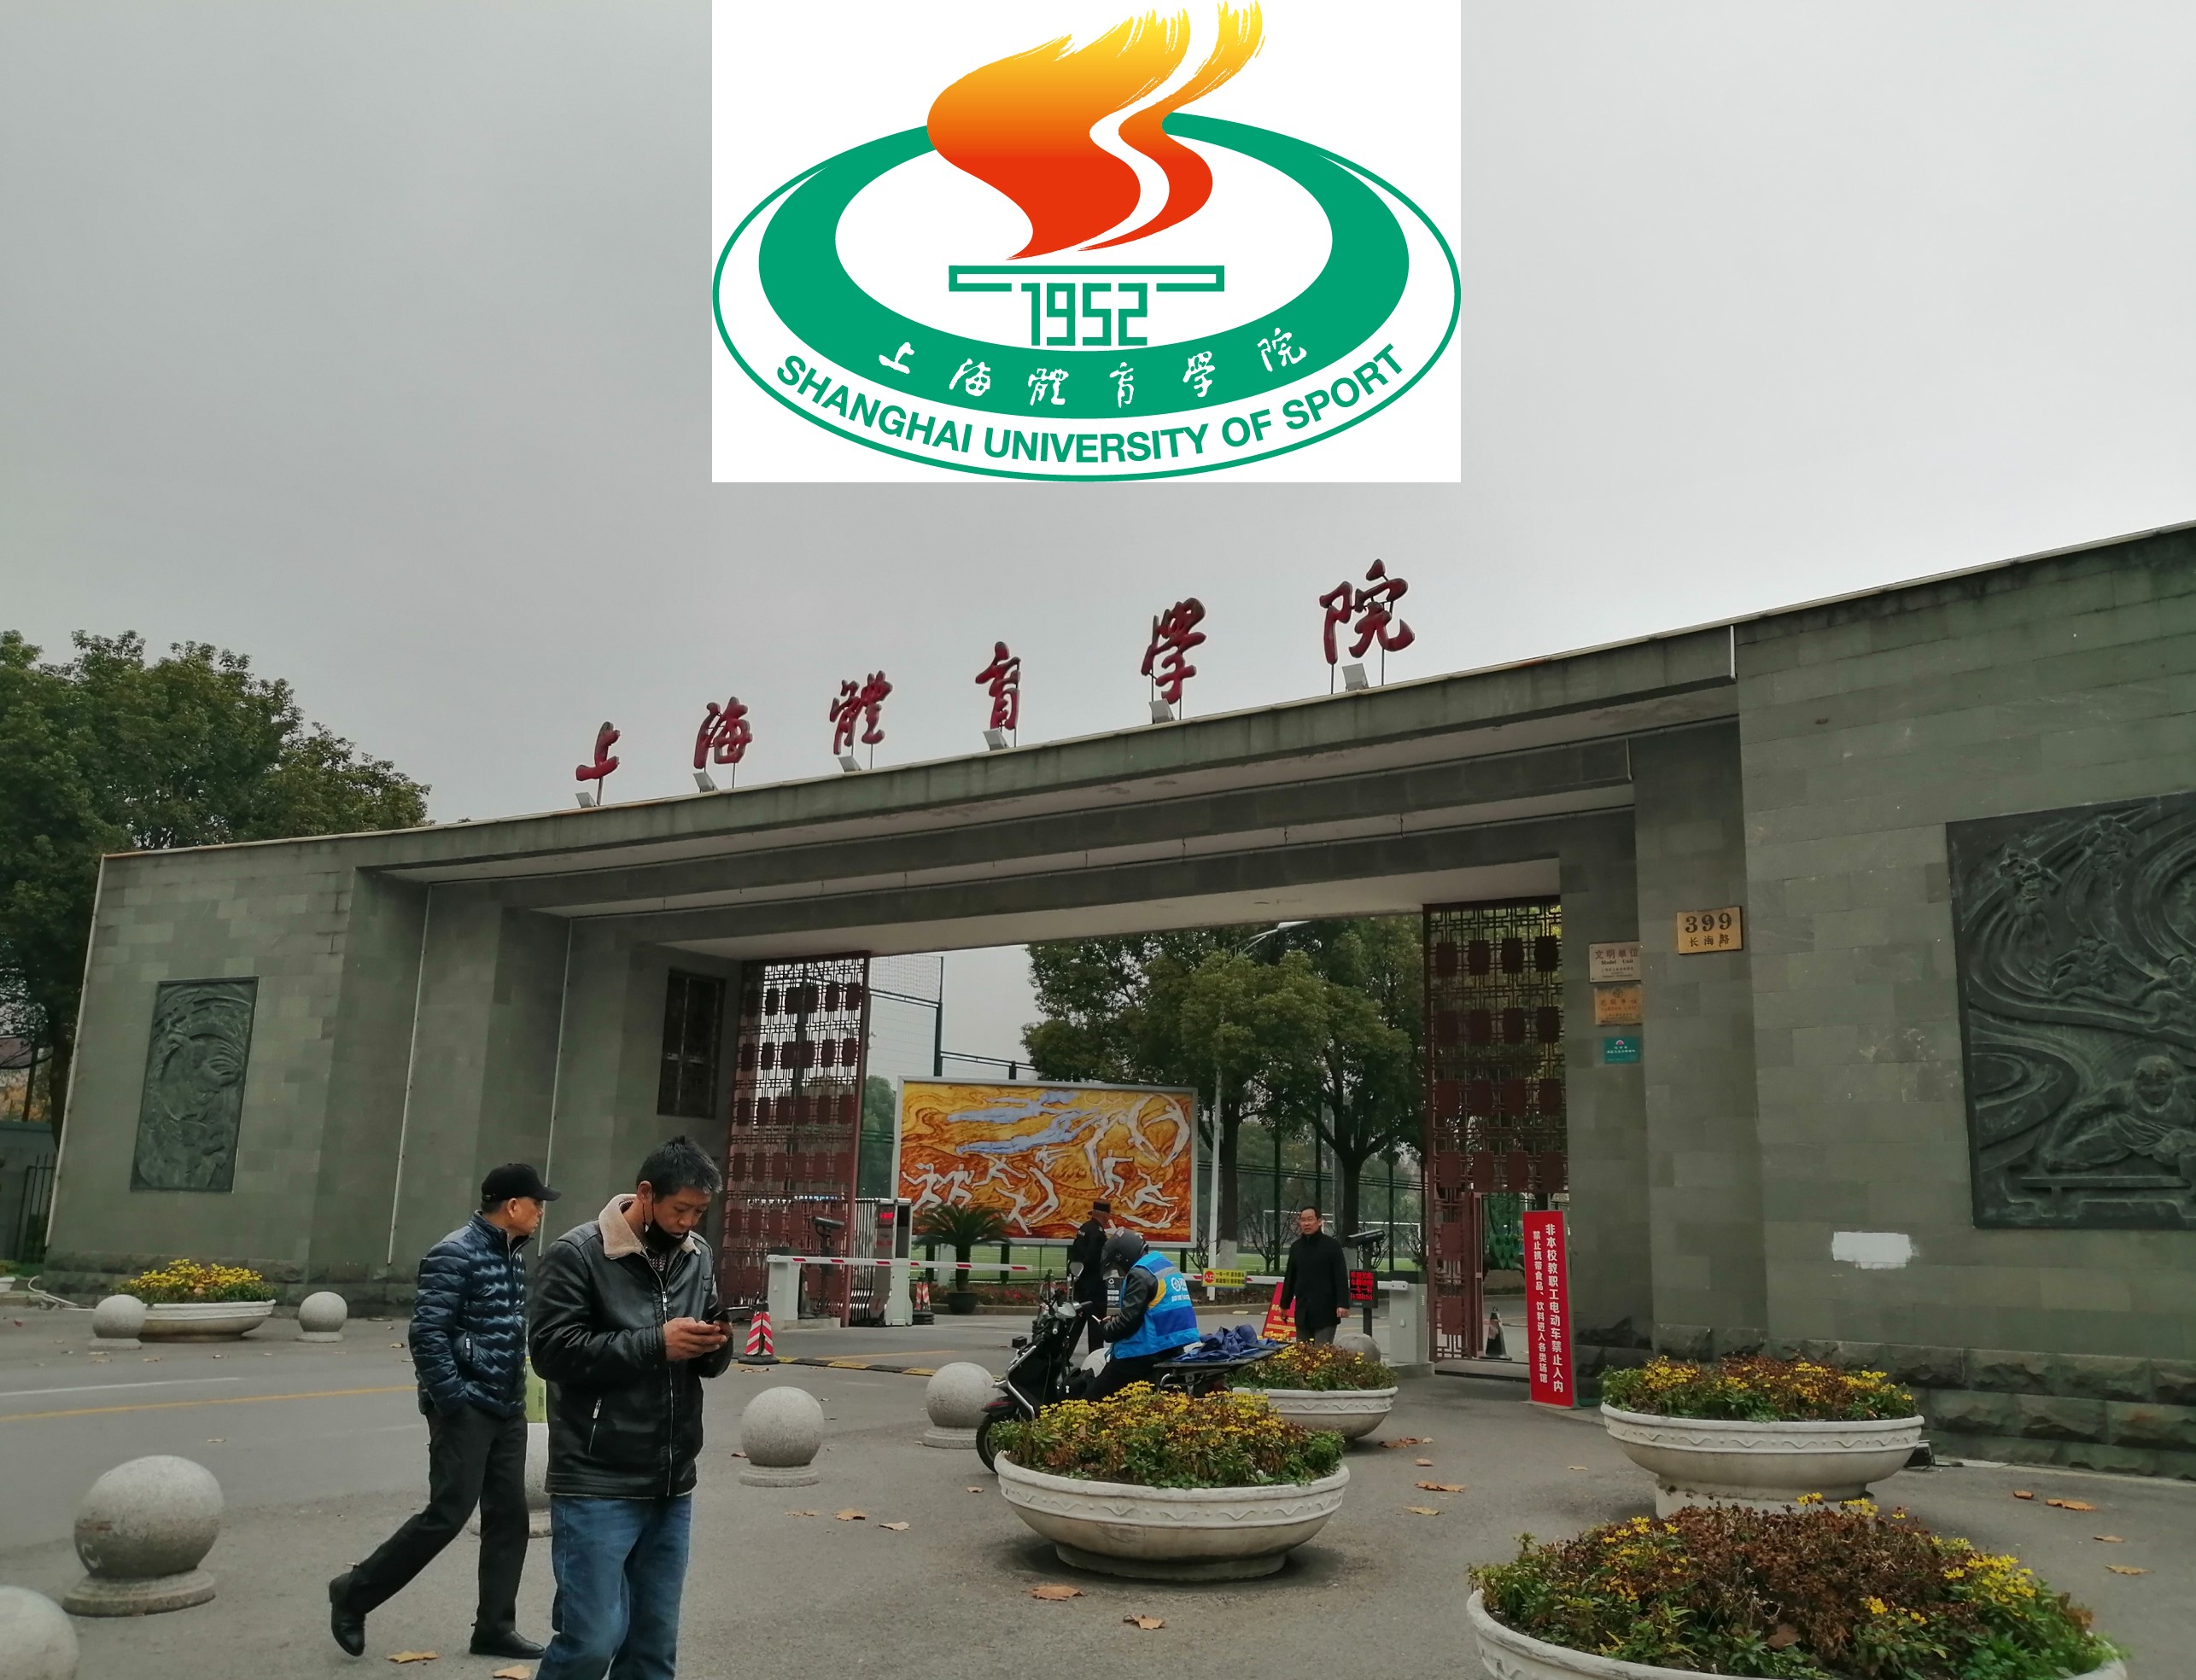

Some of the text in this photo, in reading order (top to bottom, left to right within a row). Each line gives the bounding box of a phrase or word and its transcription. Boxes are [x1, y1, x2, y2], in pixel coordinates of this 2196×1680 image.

[1685, 913, 1732, 933] 399
[1545, 1223, 1564, 1392] 非本校教职工电动车禁止入内
